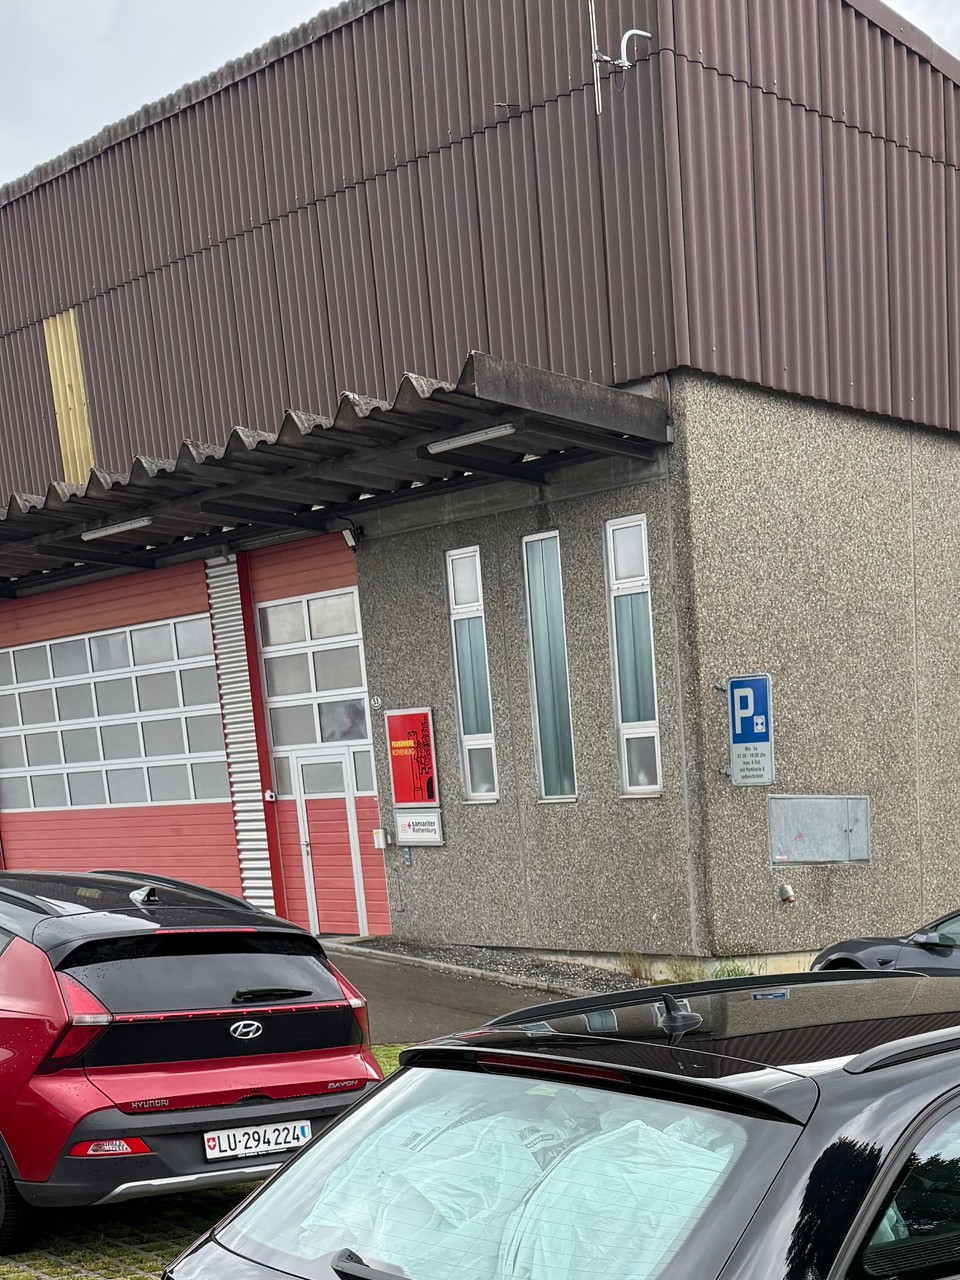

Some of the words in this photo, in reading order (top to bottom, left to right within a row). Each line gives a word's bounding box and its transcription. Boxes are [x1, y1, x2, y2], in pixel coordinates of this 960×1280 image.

[733, 687, 754, 734] P
[327, 1080, 358, 1089] BAYON
[131, 1099, 169, 1109] HYUNDAI
